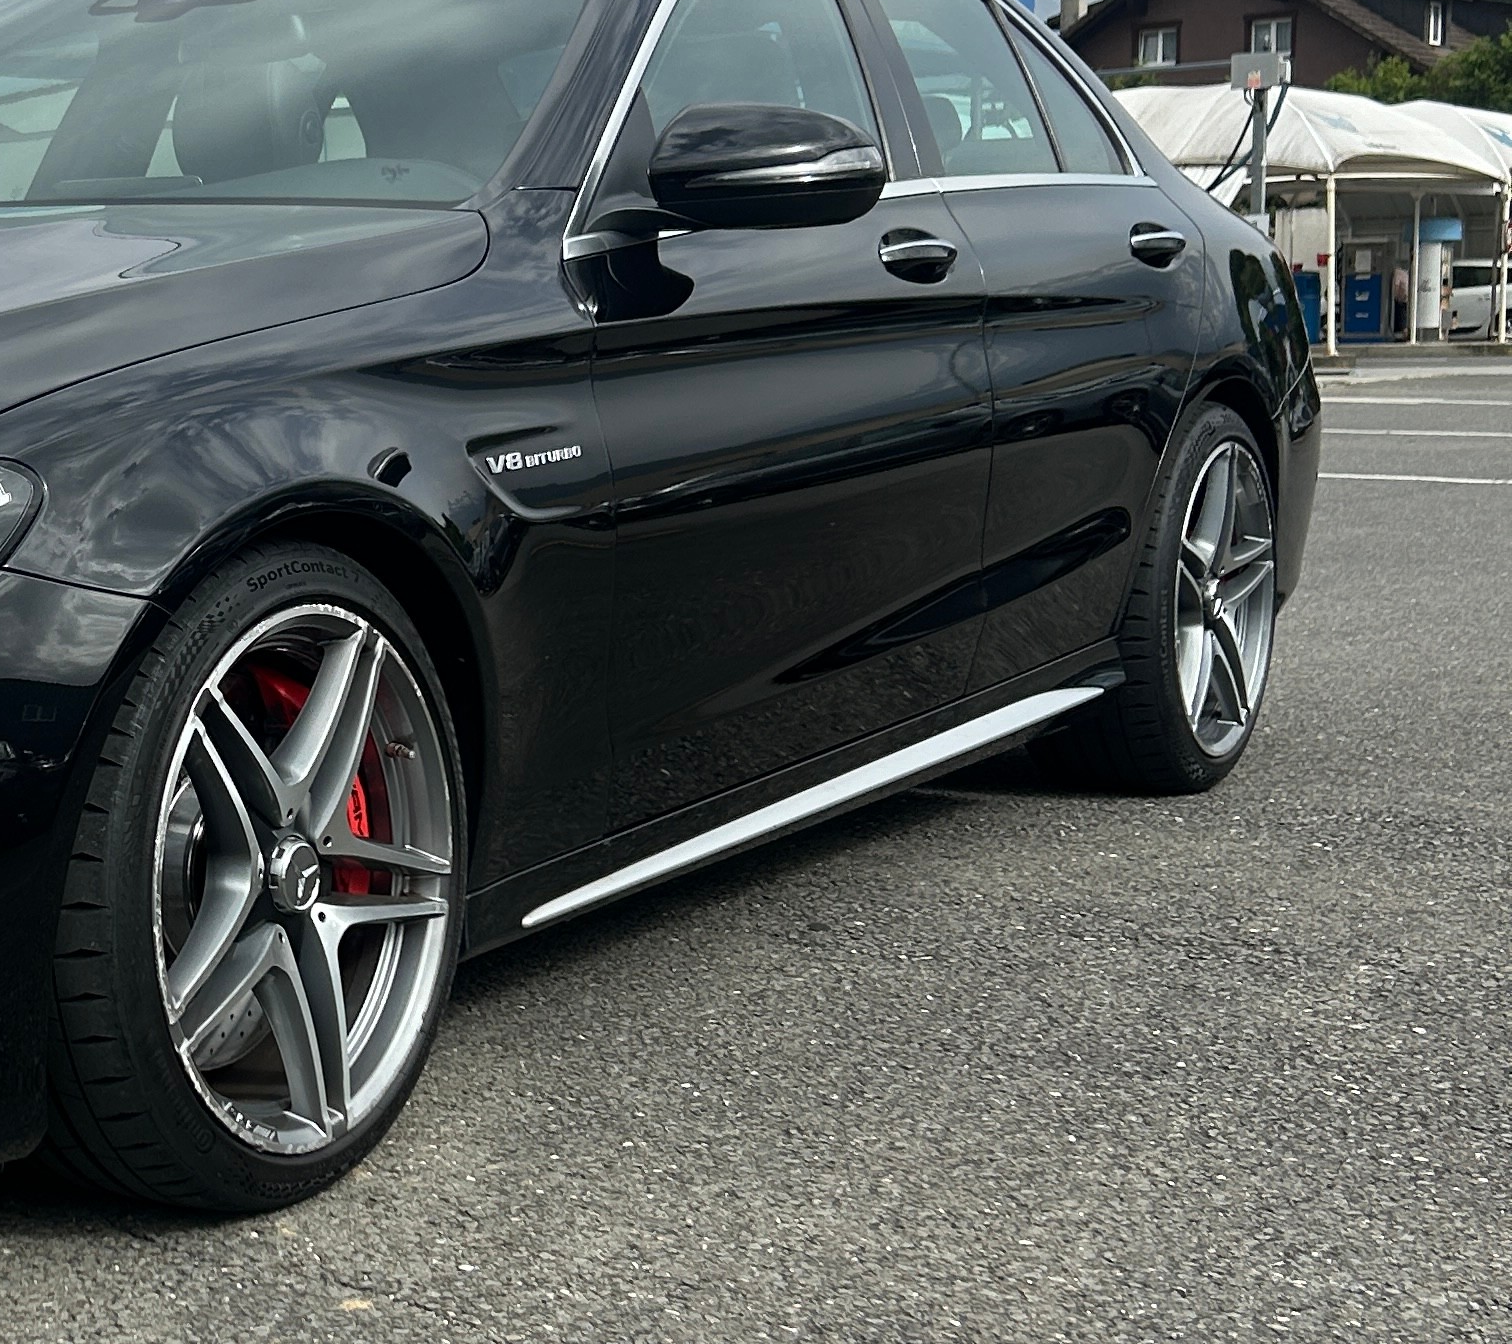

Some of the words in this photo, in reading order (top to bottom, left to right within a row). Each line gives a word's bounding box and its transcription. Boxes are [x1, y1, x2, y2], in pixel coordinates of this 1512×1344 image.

[486, 452, 523, 474] V8
[525, 445, 582, 468] BITURBO
[246, 560, 348, 593] SportContact
